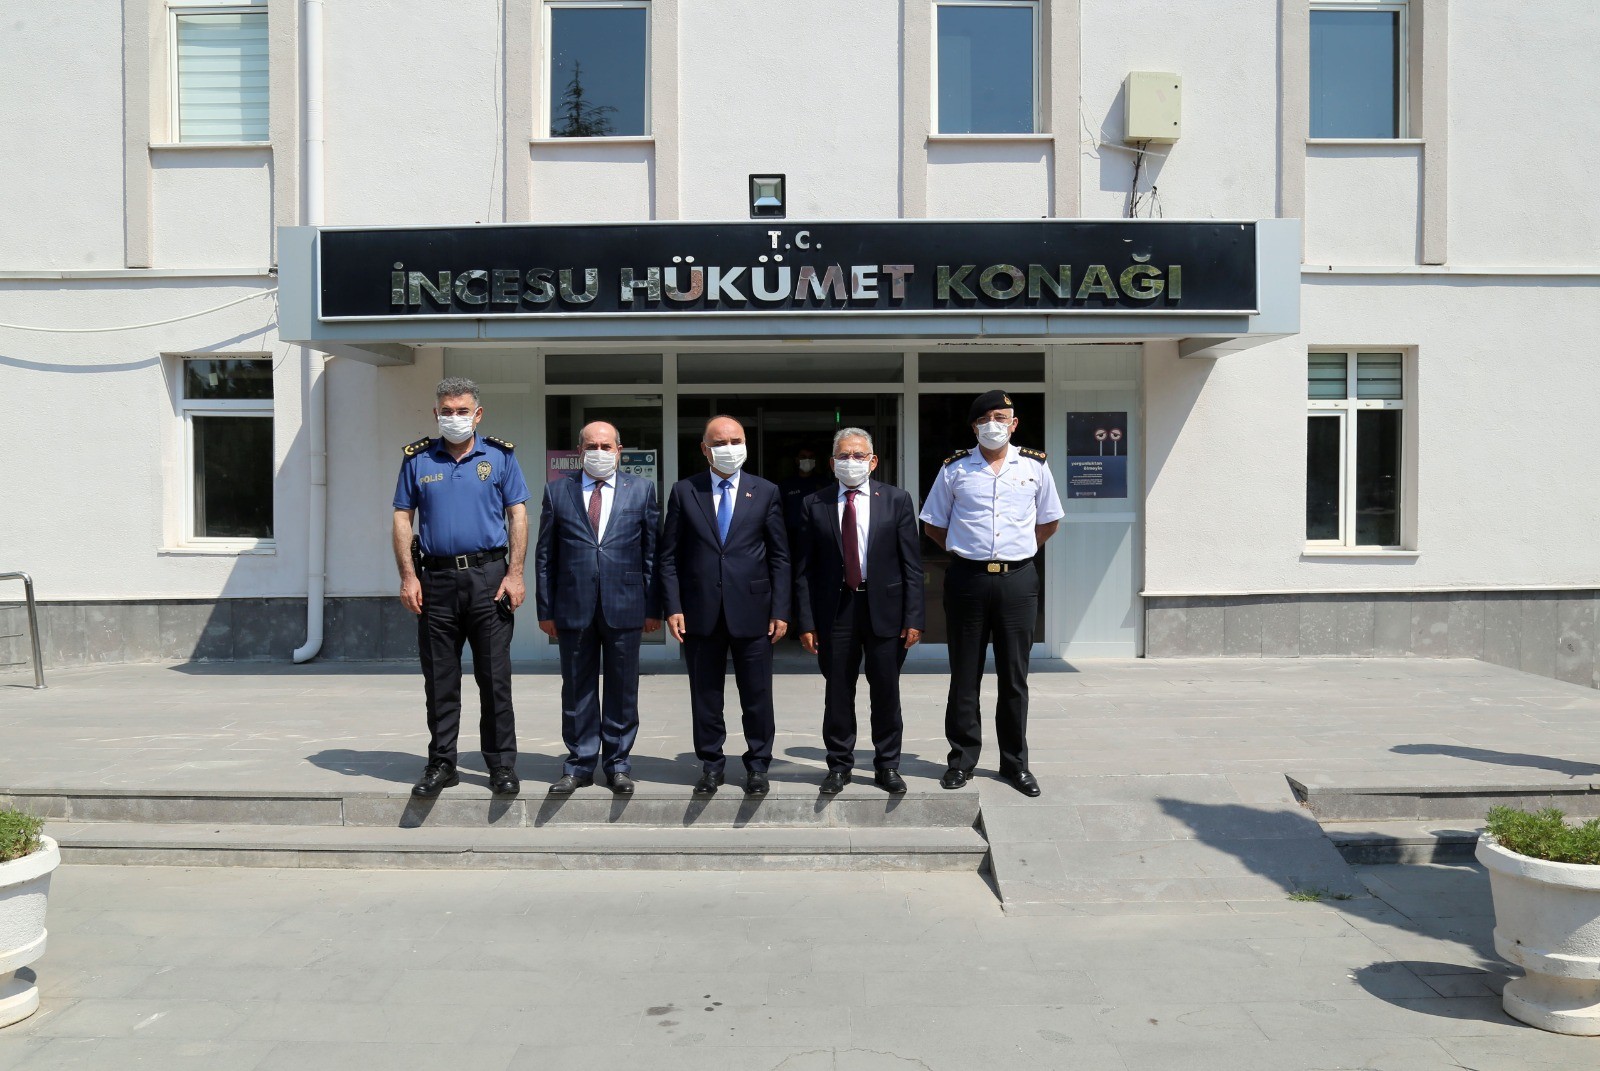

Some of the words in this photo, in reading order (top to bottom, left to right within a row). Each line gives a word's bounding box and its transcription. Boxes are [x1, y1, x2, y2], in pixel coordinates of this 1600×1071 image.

[391, 262, 599, 305] İNCESU
[621, 255, 915, 301] HÜKÜMET
[936, 253, 1182, 299] KONAĞI
